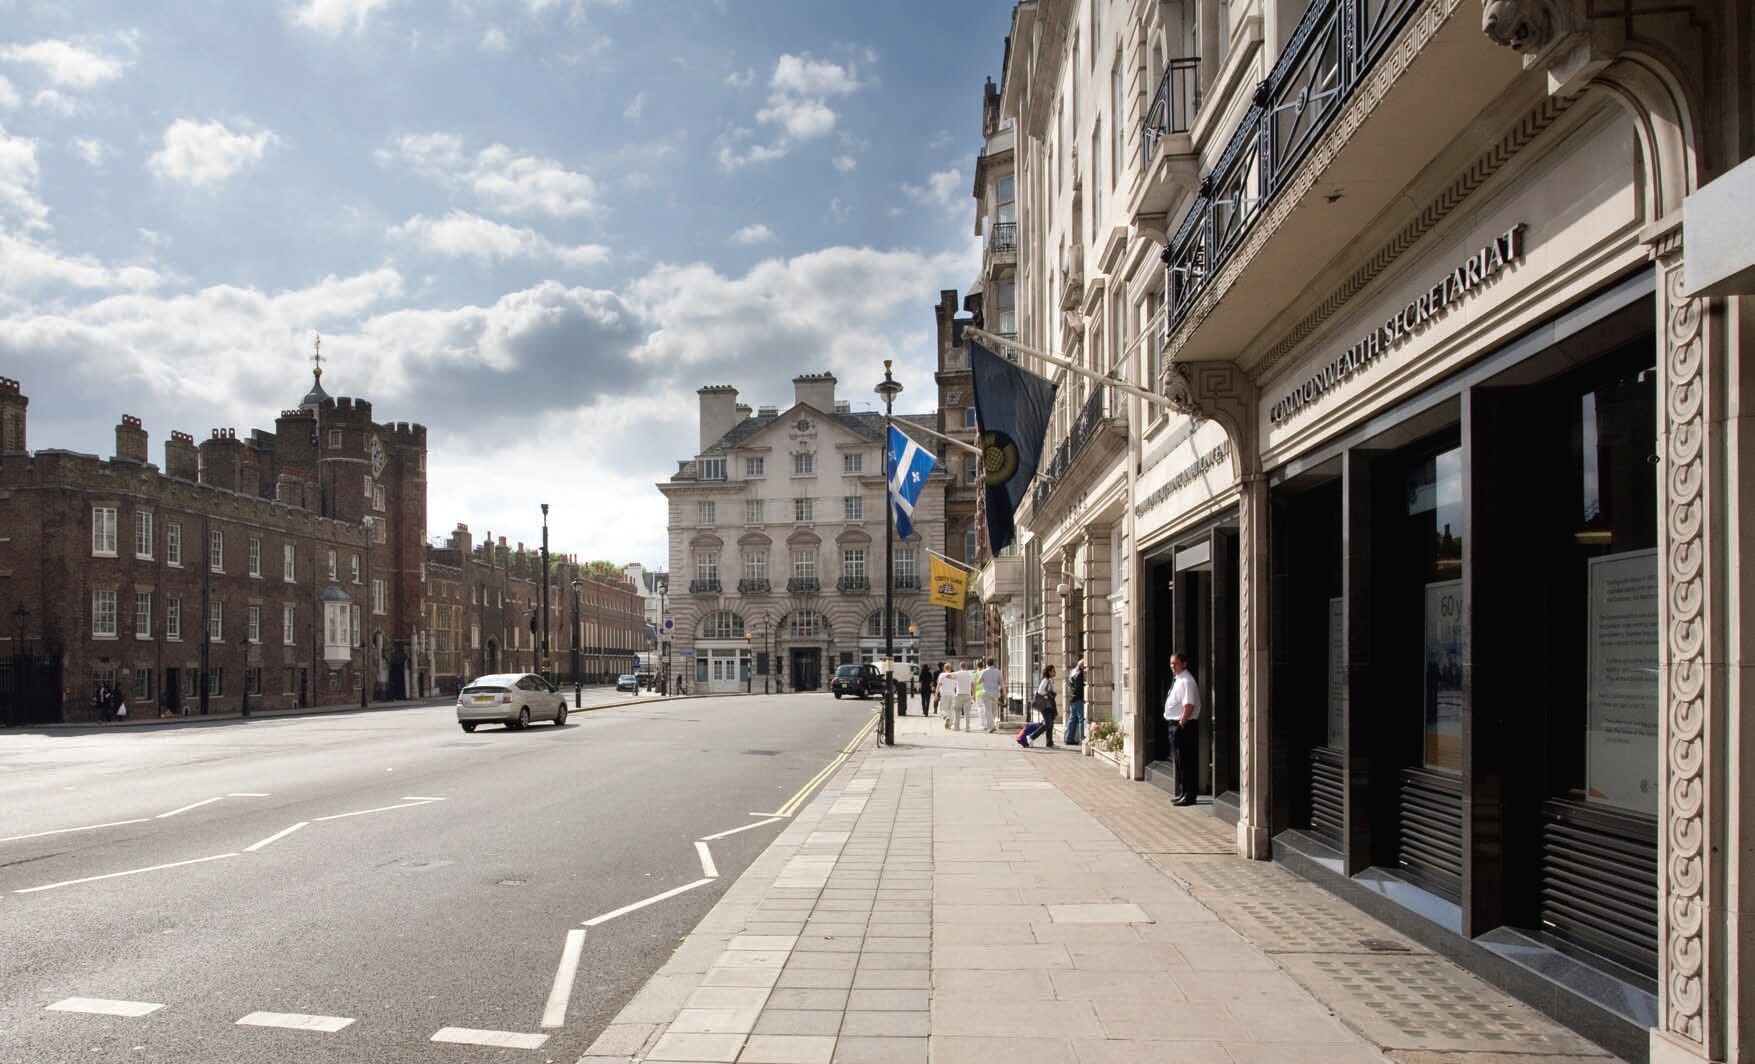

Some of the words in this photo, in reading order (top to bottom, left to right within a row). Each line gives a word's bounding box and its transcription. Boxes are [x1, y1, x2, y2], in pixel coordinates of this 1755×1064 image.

[1270, 329, 1380, 423] COMMONWEALTH
[1384, 222, 1528, 347] SECRETARIAT
[1441, 595, 1454, 617] 60
